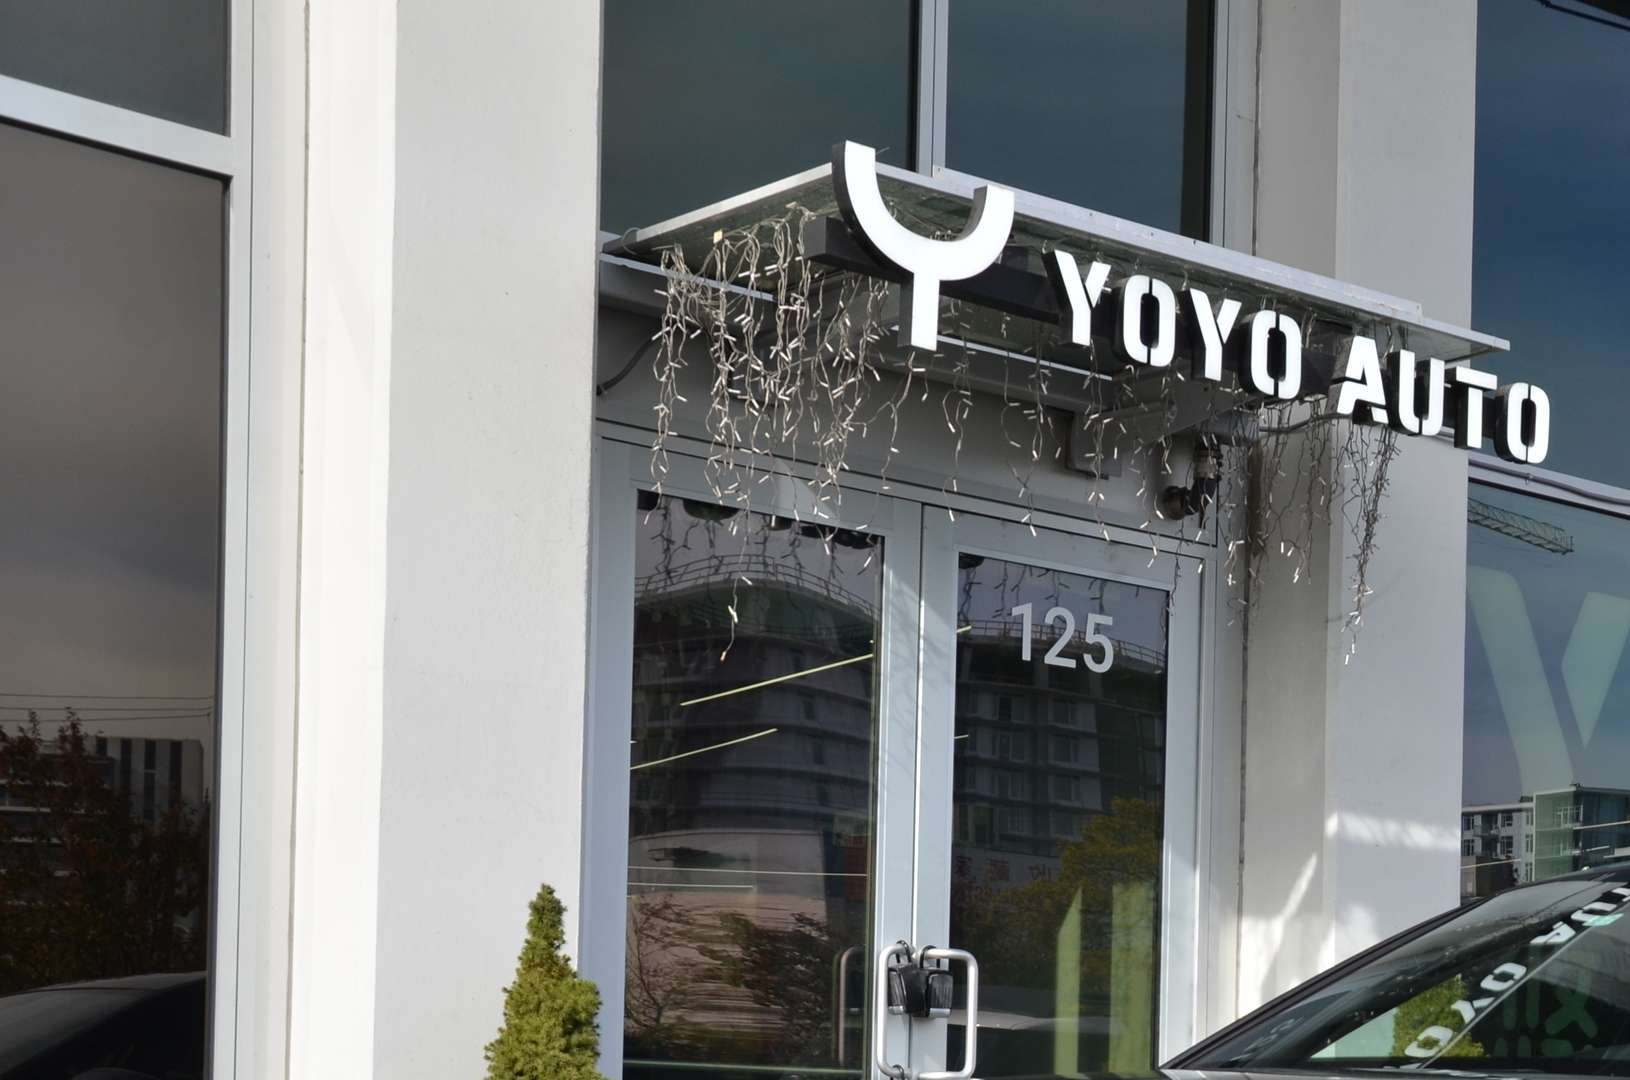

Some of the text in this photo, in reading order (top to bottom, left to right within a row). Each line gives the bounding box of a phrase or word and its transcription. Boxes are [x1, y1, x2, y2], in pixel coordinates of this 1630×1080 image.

[1053, 249, 1550, 464] YOYO AUTO
[1012, 602, 1114, 673] 125
